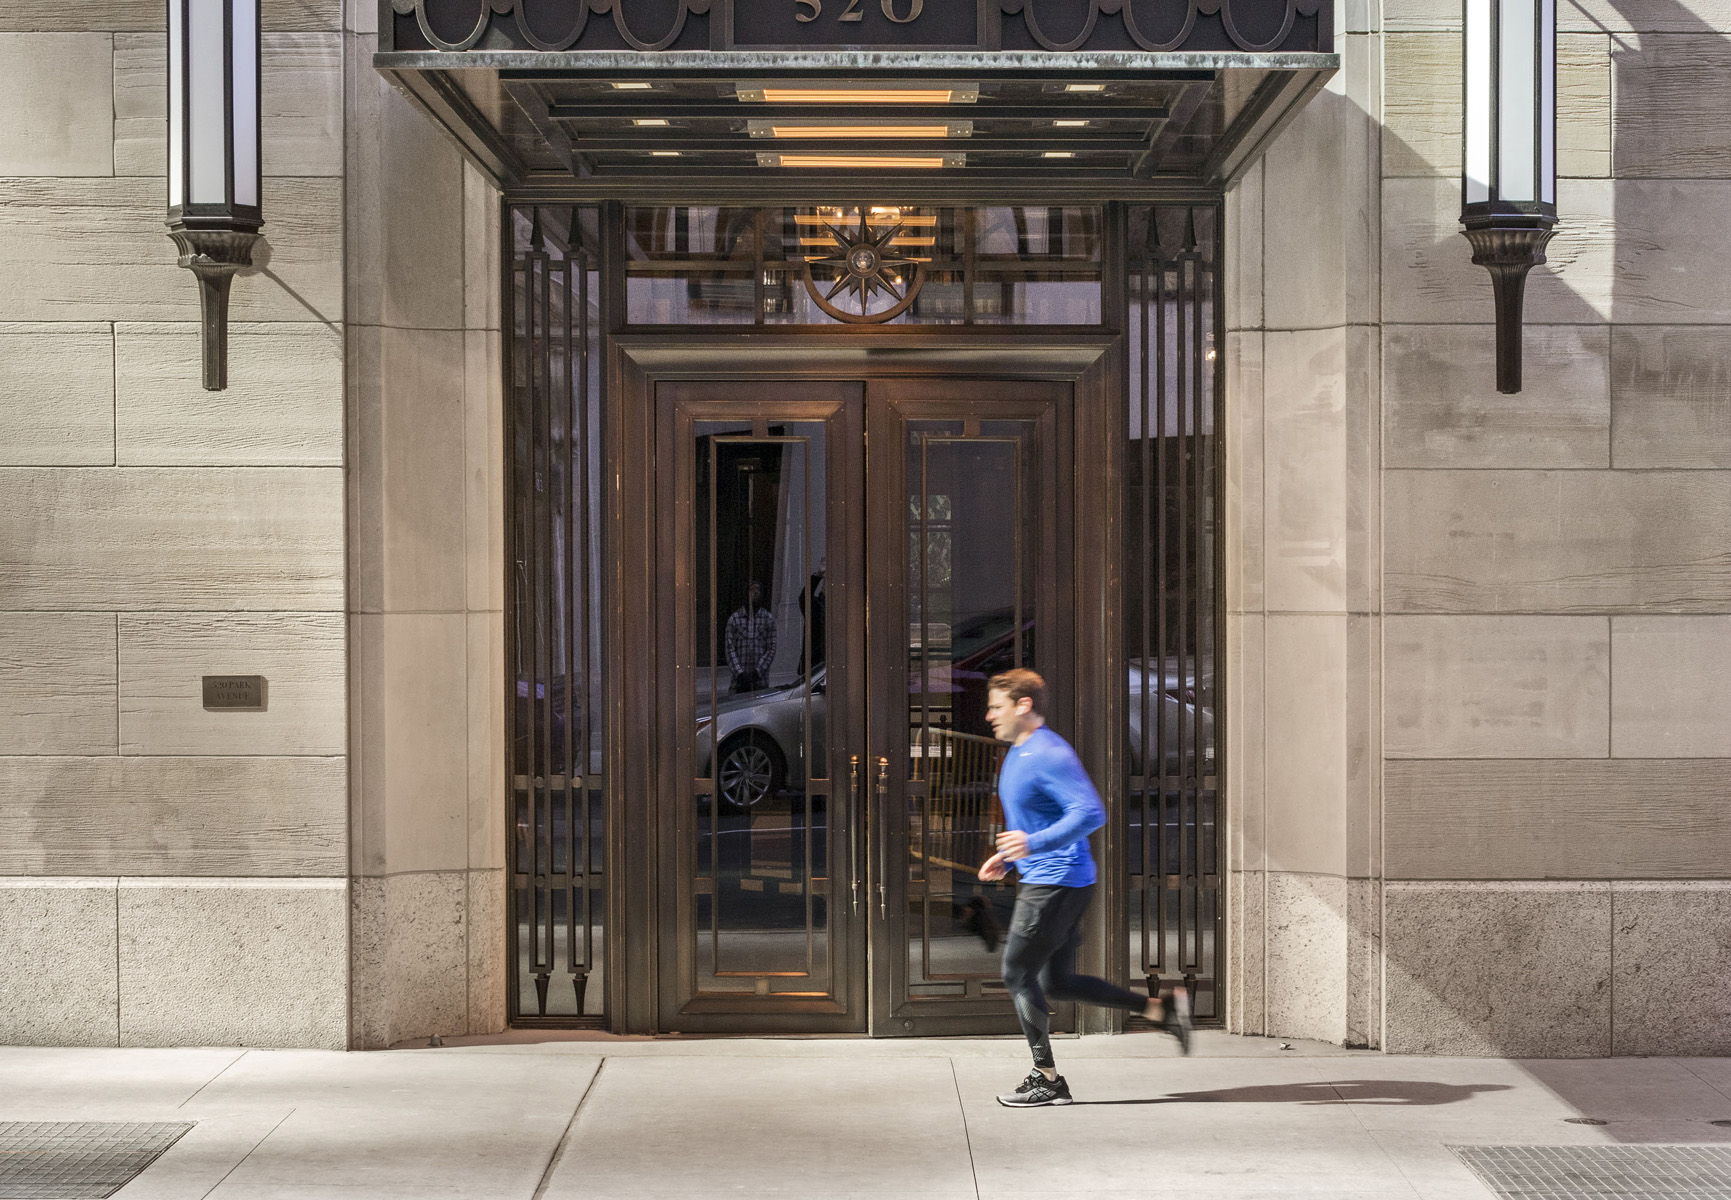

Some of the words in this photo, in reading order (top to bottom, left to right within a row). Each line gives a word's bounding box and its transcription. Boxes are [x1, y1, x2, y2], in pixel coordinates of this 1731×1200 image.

[211, 680, 228, 689] 520
[229, 680, 251, 689] PARK
[216, 692, 249, 700] AVENUE
